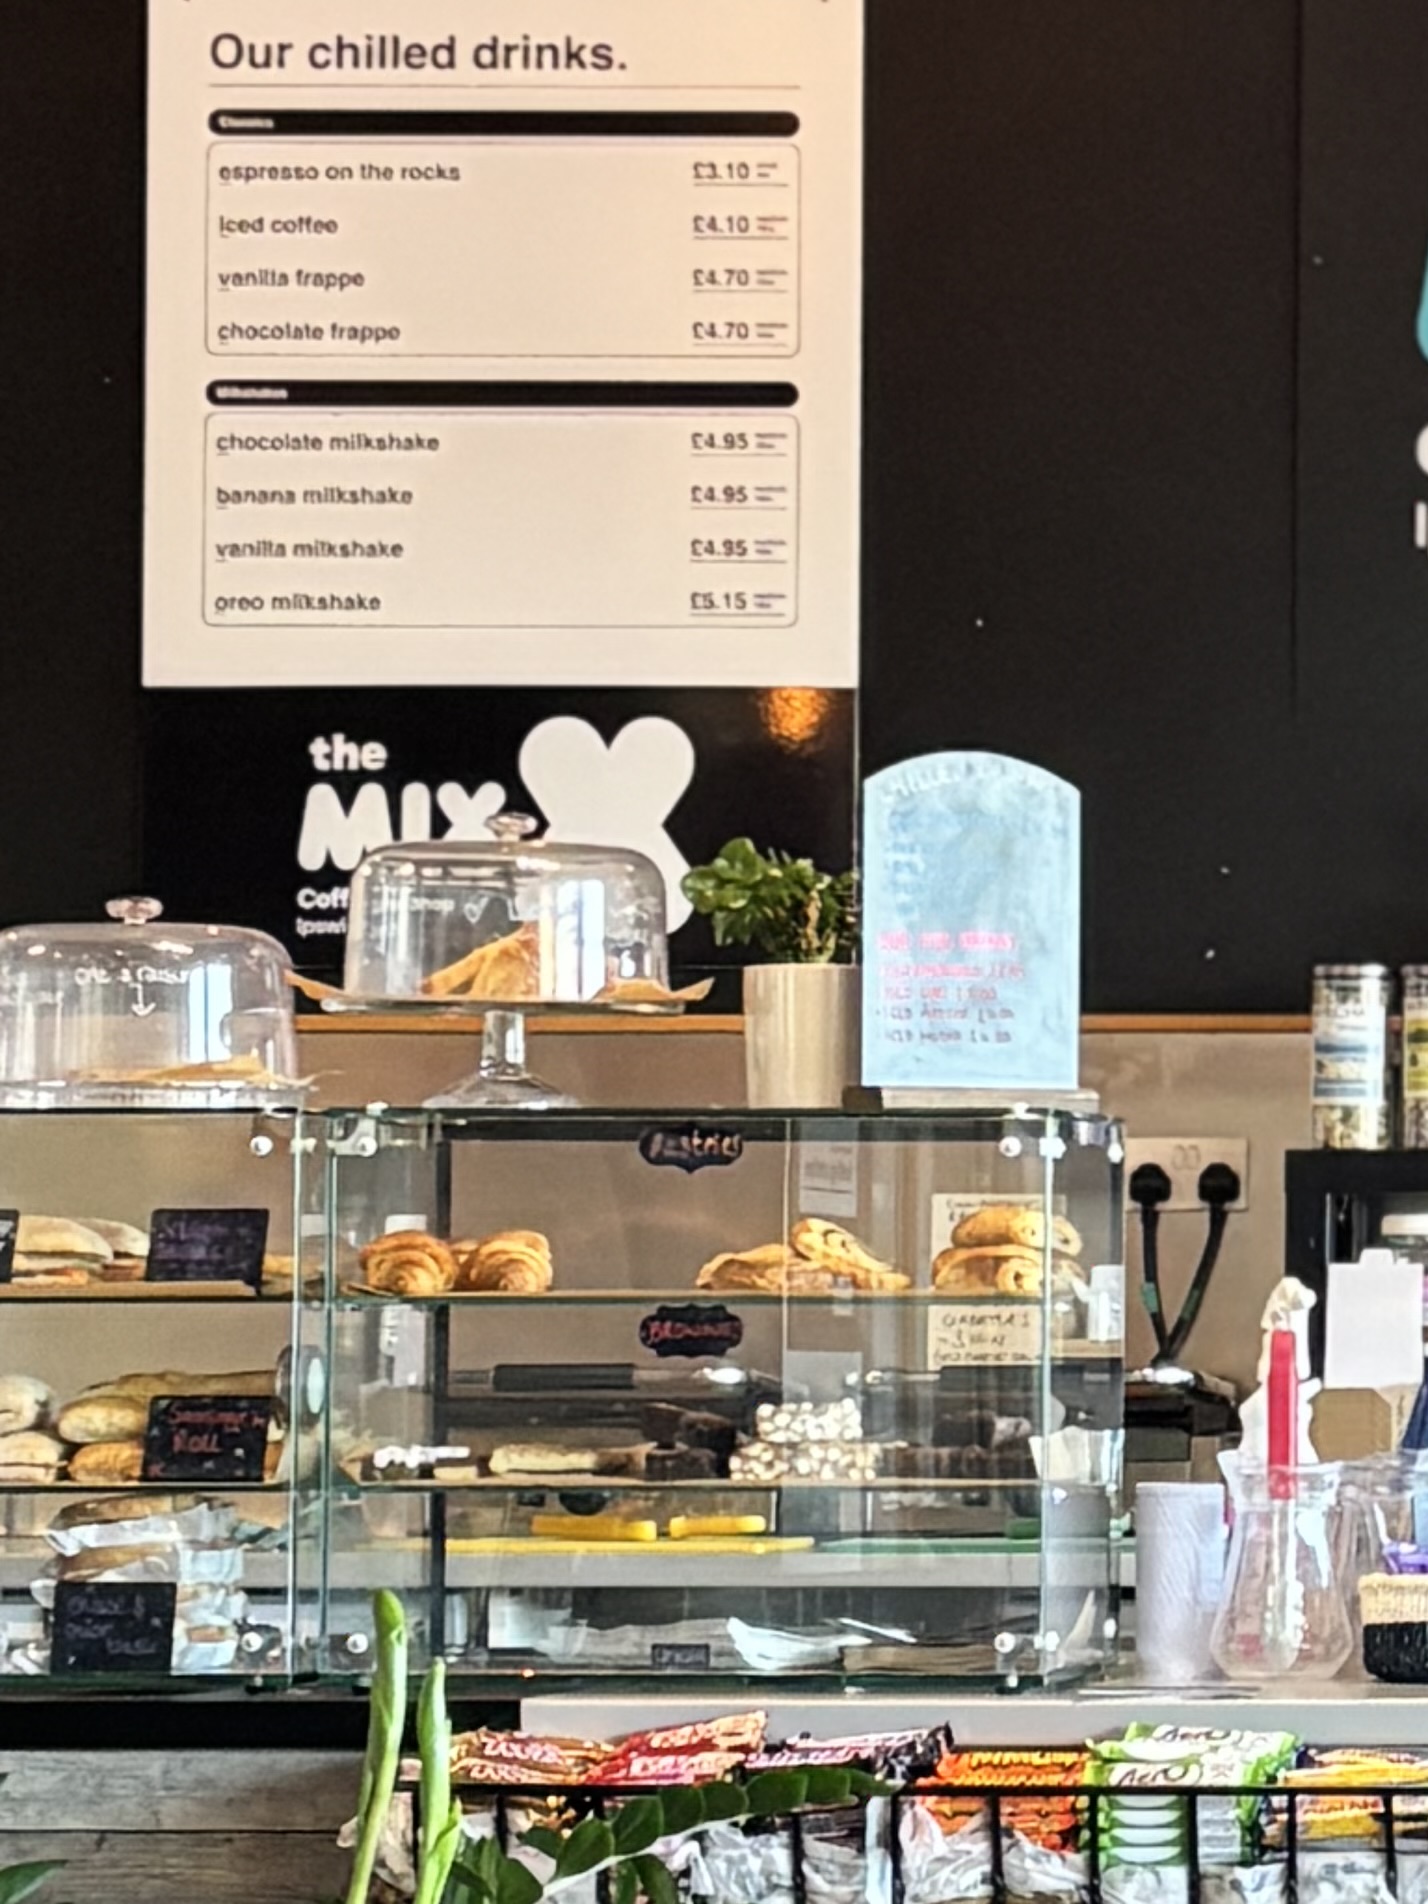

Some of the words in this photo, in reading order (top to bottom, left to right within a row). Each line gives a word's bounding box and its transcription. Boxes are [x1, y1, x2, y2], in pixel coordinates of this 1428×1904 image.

[209, 32, 294, 72] Our
[306, 33, 457, 72] chilled
[471, 34, 628, 73] drinks.
[219, 164, 319, 185] espresso
[325, 165, 354, 181] on
[360, 163, 394, 181] the
[401, 163, 461, 181] rocks
[270, 215, 338, 234] coffee
[218, 269, 289, 288] vanilla
[295, 269, 365, 292] frappe
[693, 268, 750, 287] £4.70
[217, 322, 324, 341] chocolate
[330, 322, 401, 345] frappe
[692, 321, 749, 340] £4.70
[216, 431, 323, 452] chocolate
[329, 431, 440, 452] milkshake
[691, 432, 748, 450] £4.95
[216, 485, 296, 505] banana
[302, 485, 413, 505] milkshake
[215, 539, 287, 558] vanilla
[292, 539, 404, 558] milkshake
[214, 594, 264, 612] oreo
[271, 592, 381, 612] milkshake
[309, 734, 387, 771] the
